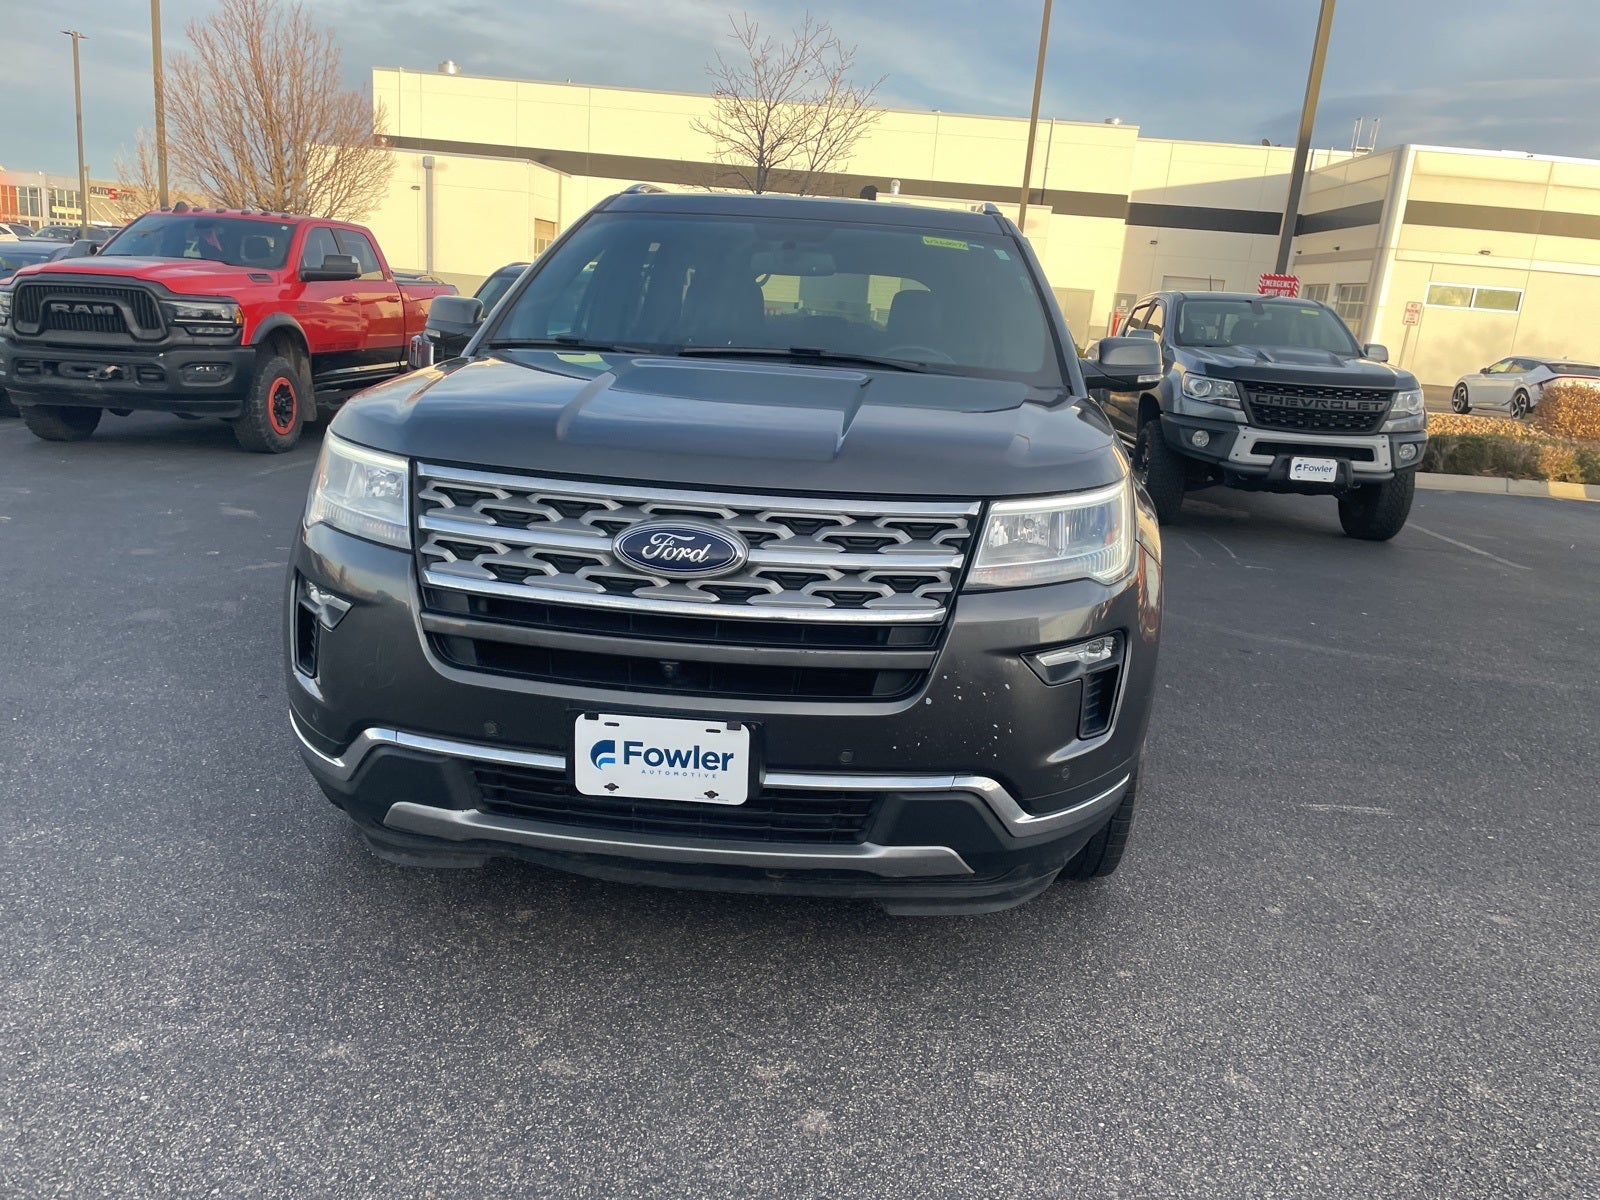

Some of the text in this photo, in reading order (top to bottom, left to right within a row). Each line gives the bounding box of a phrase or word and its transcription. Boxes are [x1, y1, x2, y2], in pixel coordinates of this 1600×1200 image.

[1263, 279, 1295, 288] EMERGENCY
[50, 303, 115, 315] RAM
[1254, 394, 1383, 411] CHEVROLET
[1303, 463, 1333, 473] Fowler
[641, 532, 712, 564] Ford
[623, 740, 735, 771] Fowler
[641, 769, 717, 778] AUTOMOTIVE
